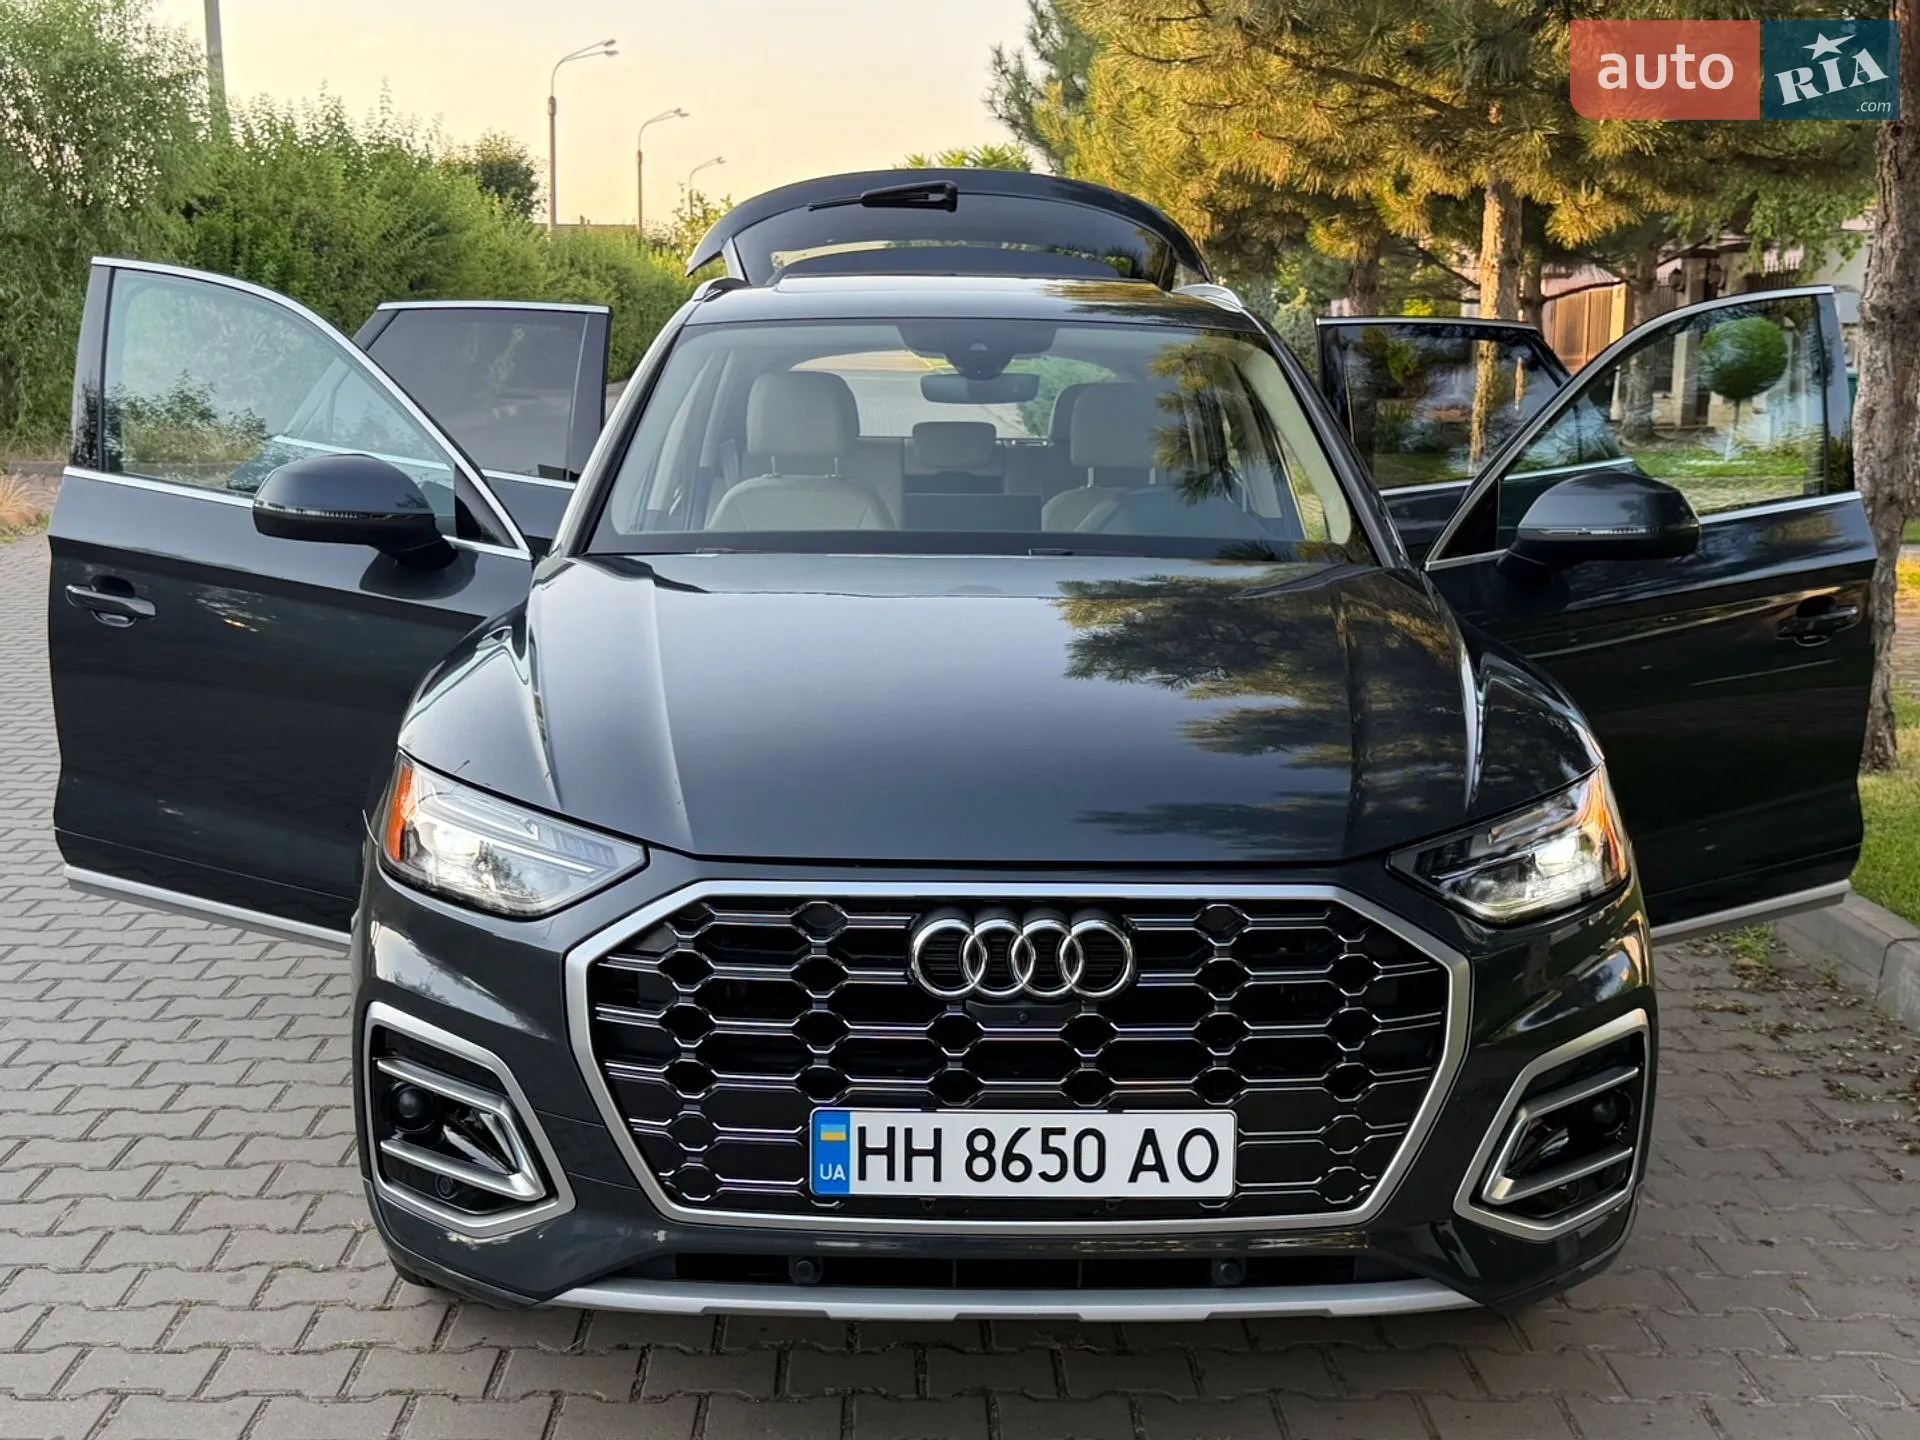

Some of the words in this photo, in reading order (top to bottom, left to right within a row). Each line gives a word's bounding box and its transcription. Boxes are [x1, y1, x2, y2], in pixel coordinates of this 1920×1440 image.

[819, 1164, 846, 1181] UA
[857, 1126, 942, 1183] HH
[964, 1127, 1107, 1183] 8650
[1127, 1127, 1220, 1184] AO
